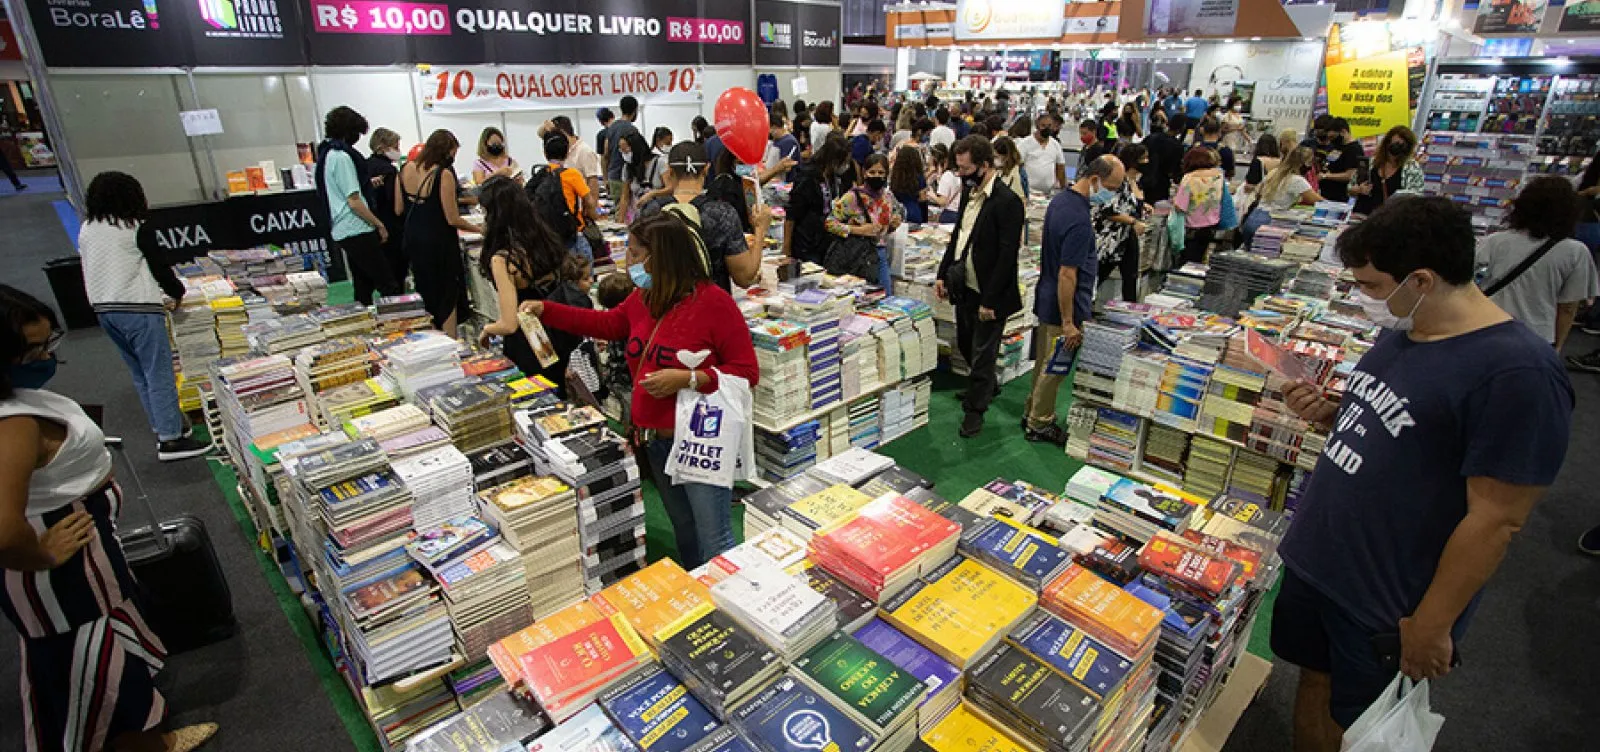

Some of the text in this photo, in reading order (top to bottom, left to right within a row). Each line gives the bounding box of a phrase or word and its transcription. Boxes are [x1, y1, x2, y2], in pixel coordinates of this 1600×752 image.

[317, 4, 742, 43] R$ 10,00 QUALQUER LIVRO R$ 10,00
[1360, 68, 1393, 78] editora
[436, 67, 695, 101] 10 QUALQUER LIVRO 10
[1349, 80, 1384, 90] número
[1341, 92, 1393, 103] na lista dos
[1352, 105, 1375, 115] mais
[1345, 116, 1382, 128] endidos
[250, 208, 316, 234] CAIXA
[154, 224, 212, 249] AIXA
[1323, 431, 1363, 475] LAND
[856, 670, 900, 712] A CIÊNCIA
[860, 673, 878, 690] DO
